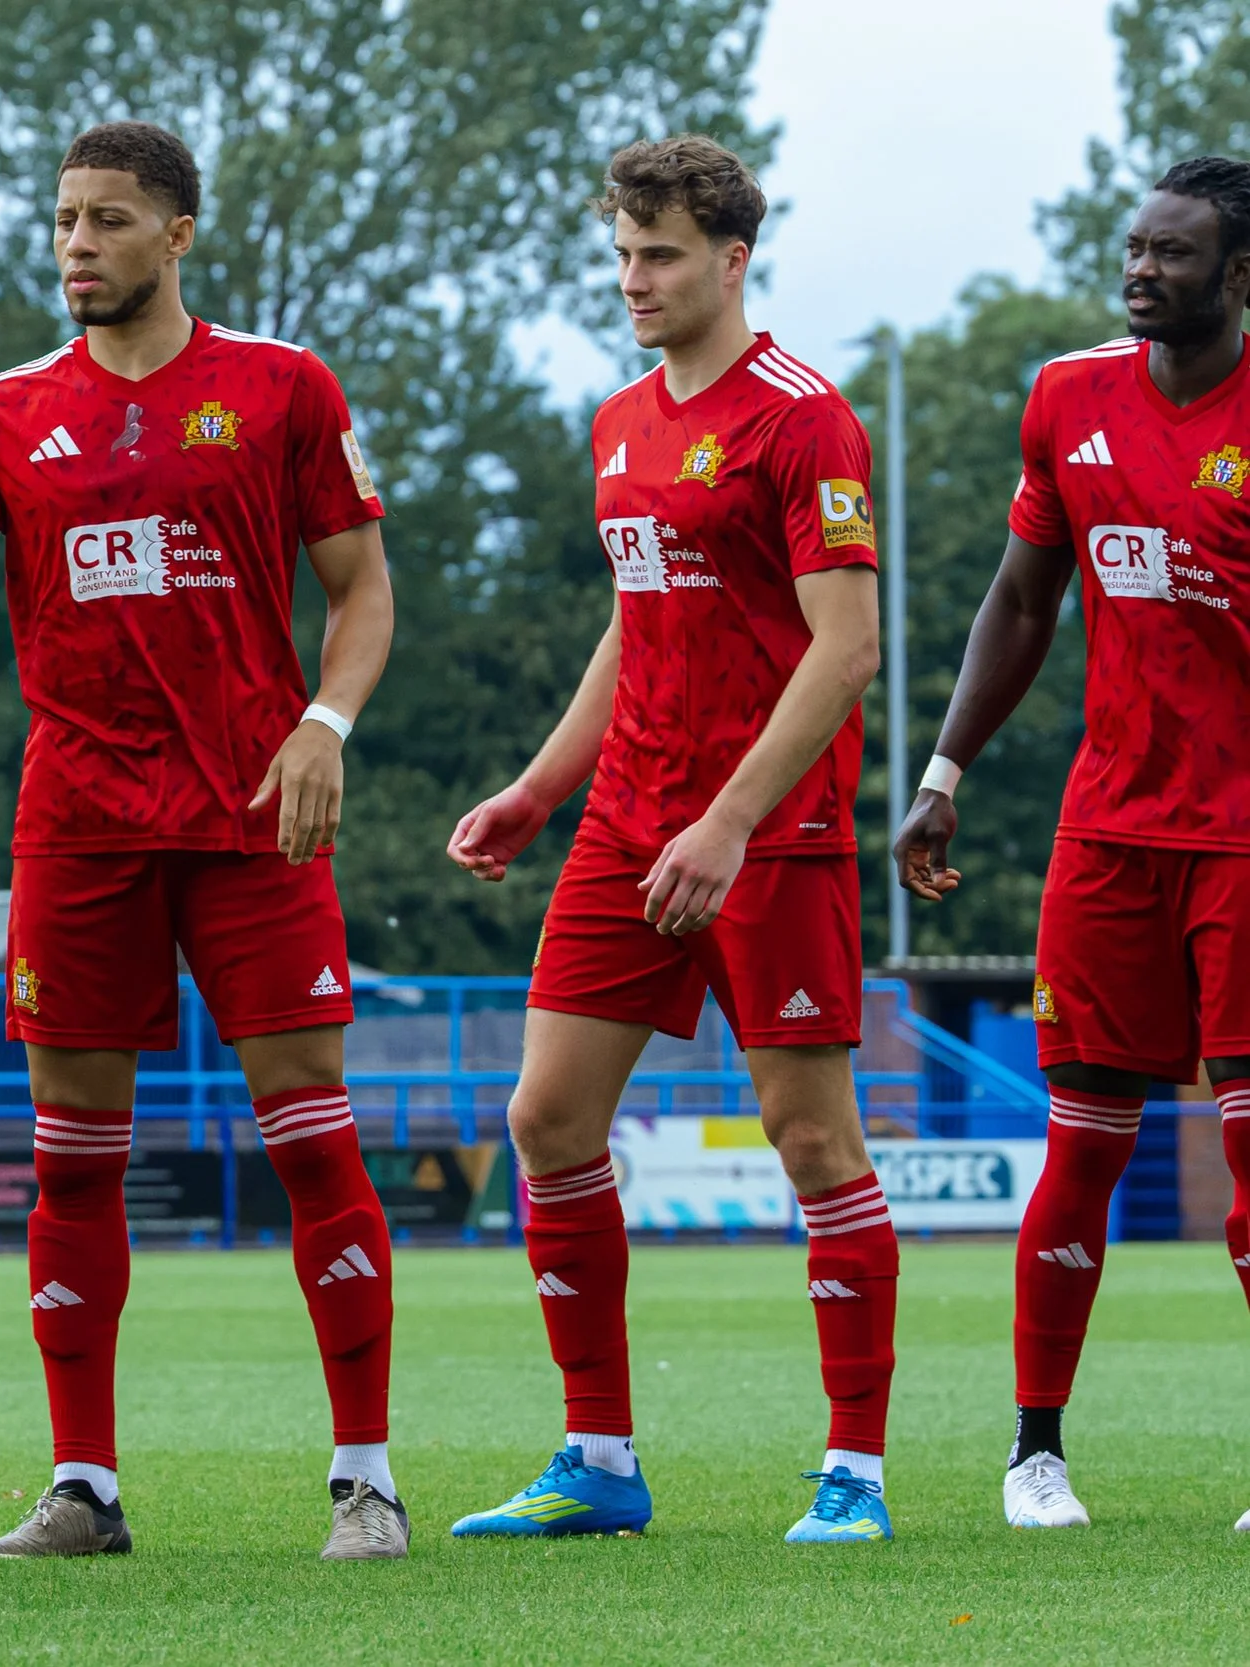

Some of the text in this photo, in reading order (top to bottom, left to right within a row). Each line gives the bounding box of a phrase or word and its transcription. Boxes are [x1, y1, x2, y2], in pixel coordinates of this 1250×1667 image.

[157, 520, 197, 537] Safe
[653, 521, 678, 539] Safe
[824, 524, 858, 537] BRIAN
[73, 530, 137, 570] CR
[606, 527, 645, 561] CR
[1095, 533, 1148, 569] CR
[1161, 535, 1191, 555] Safe
[160, 545, 222, 564] Service
[659, 546, 705, 562] Service
[77, 568, 138, 584] SAFETY AND
[630, 564, 648, 574] AND
[1165, 560, 1214, 582] Service
[77, 578, 138, 595] CONSUMABLES
[162, 571, 236, 591] Solutions
[1167, 584, 1231, 610] Solutions
